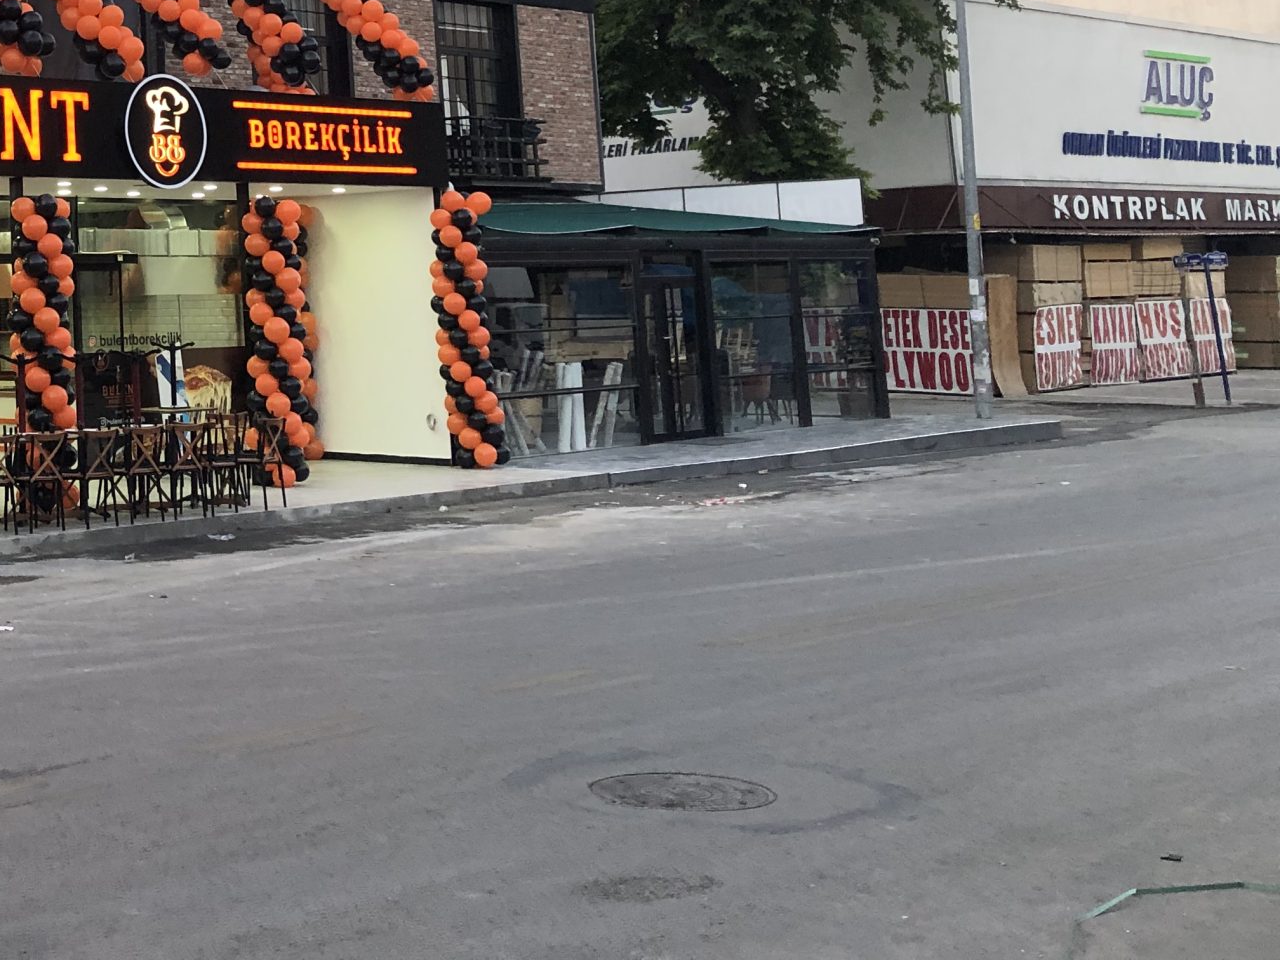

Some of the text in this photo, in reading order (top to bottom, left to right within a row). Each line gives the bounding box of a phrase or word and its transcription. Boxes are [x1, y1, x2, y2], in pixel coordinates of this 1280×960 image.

[1143, 60, 1214, 121] ALUÇ
[248, 118, 403, 161] BÖREKÇİLİK
[1053, 194, 1207, 221] KONTRPLAK
